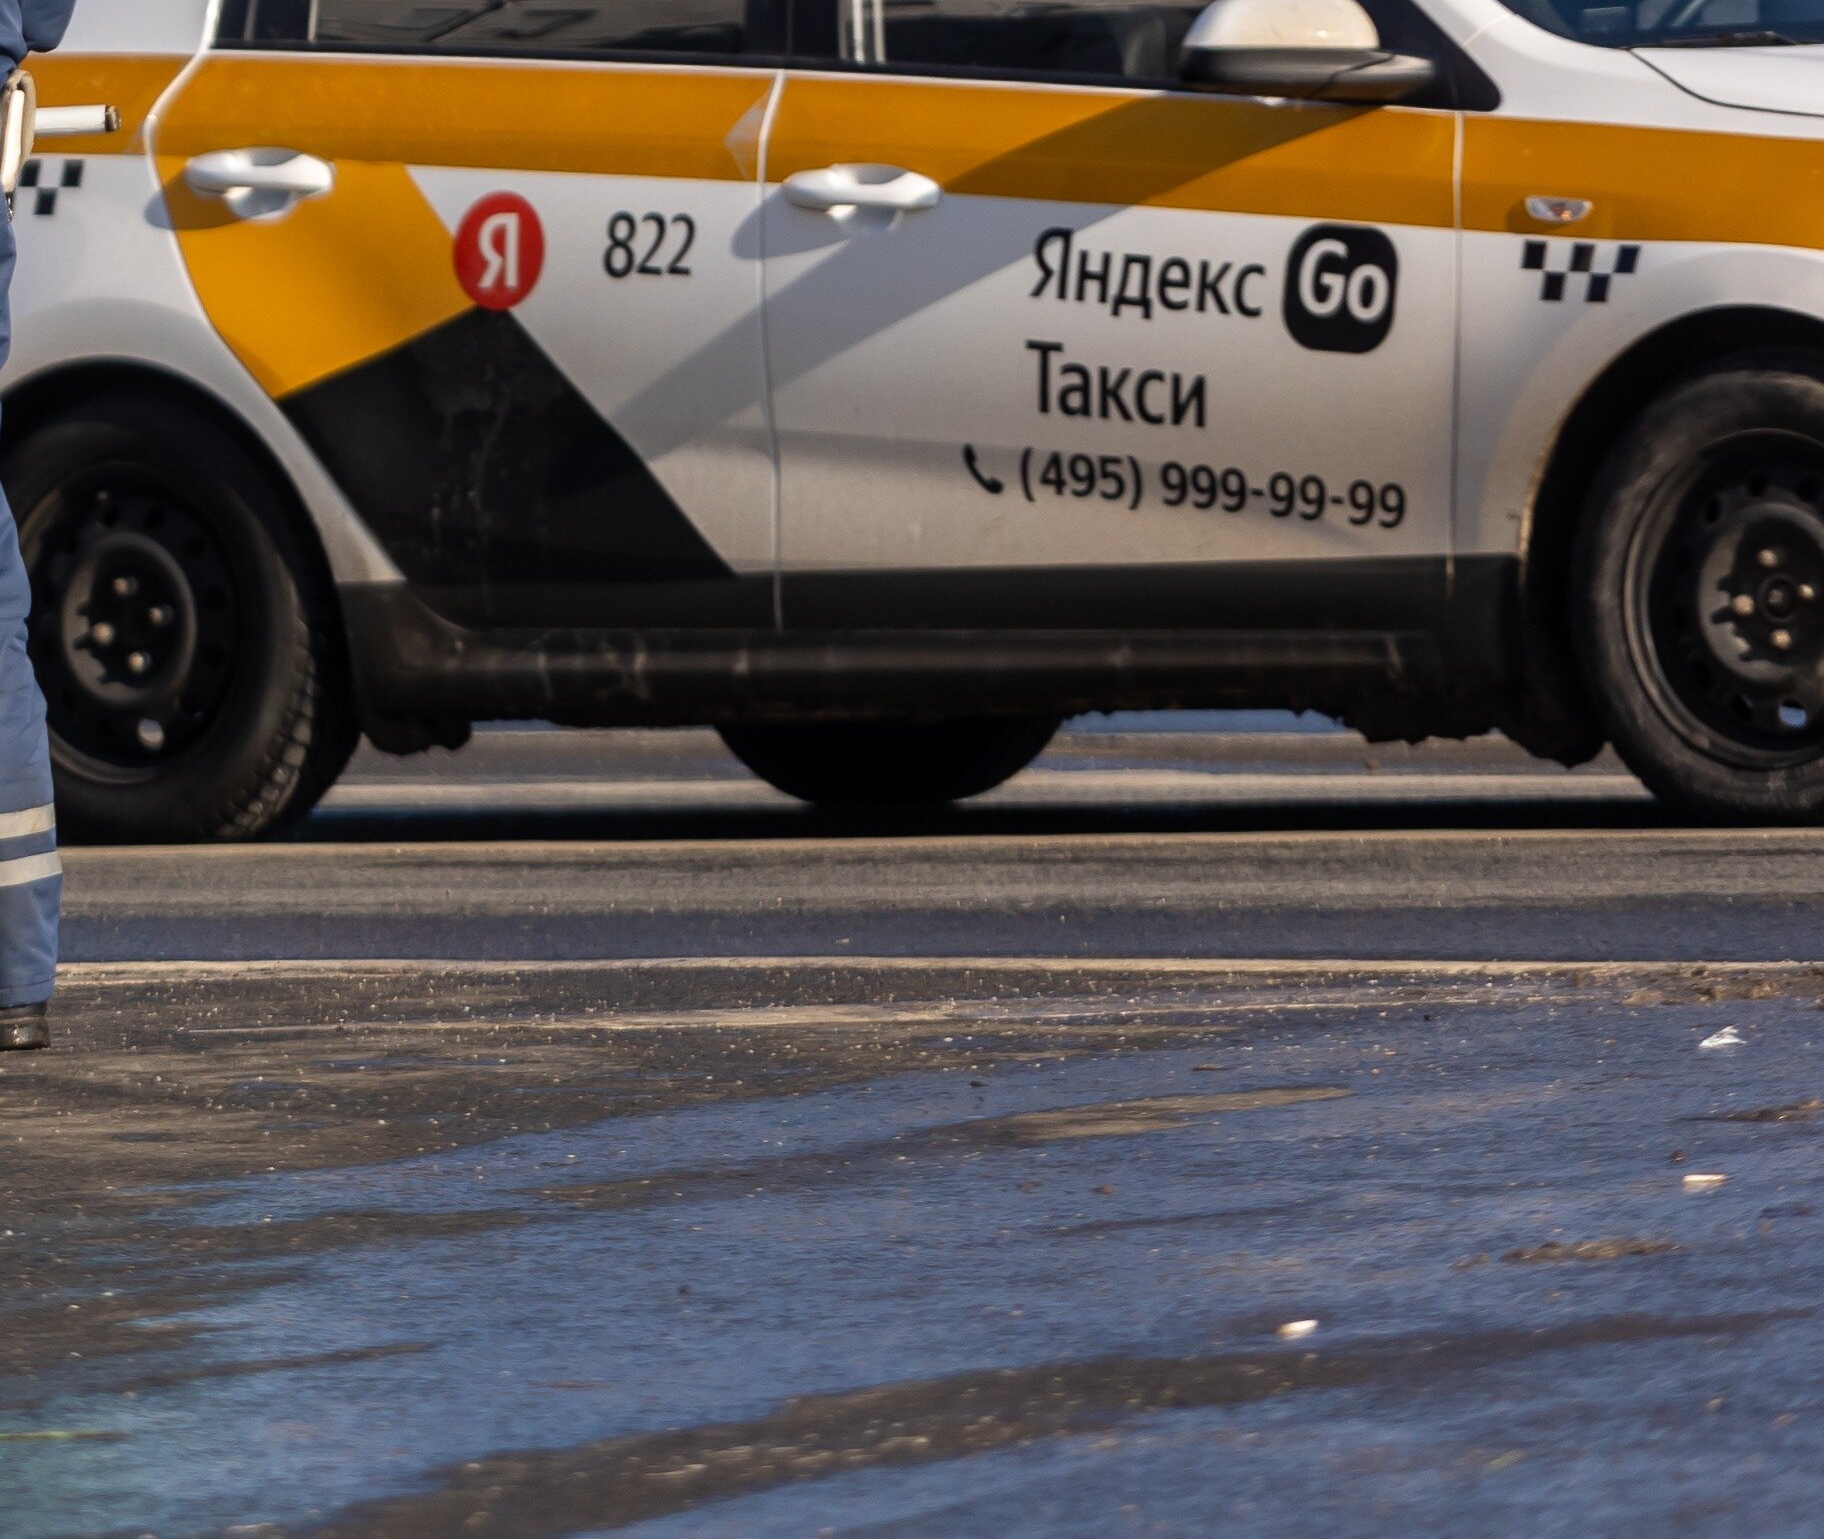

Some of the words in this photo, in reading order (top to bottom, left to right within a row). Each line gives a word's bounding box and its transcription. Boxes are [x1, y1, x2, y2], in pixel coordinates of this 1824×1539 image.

[477, 210, 519, 291] Я
[602, 211, 697, 279] 822
[1029, 227, 1266, 320] Яндекс
[1298, 238, 1394, 325] Go
[1025, 338, 1209, 429] Такси
[1020, 446, 1142, 510] (495)
[1160, 460, 1407, 530] 999-99-99
